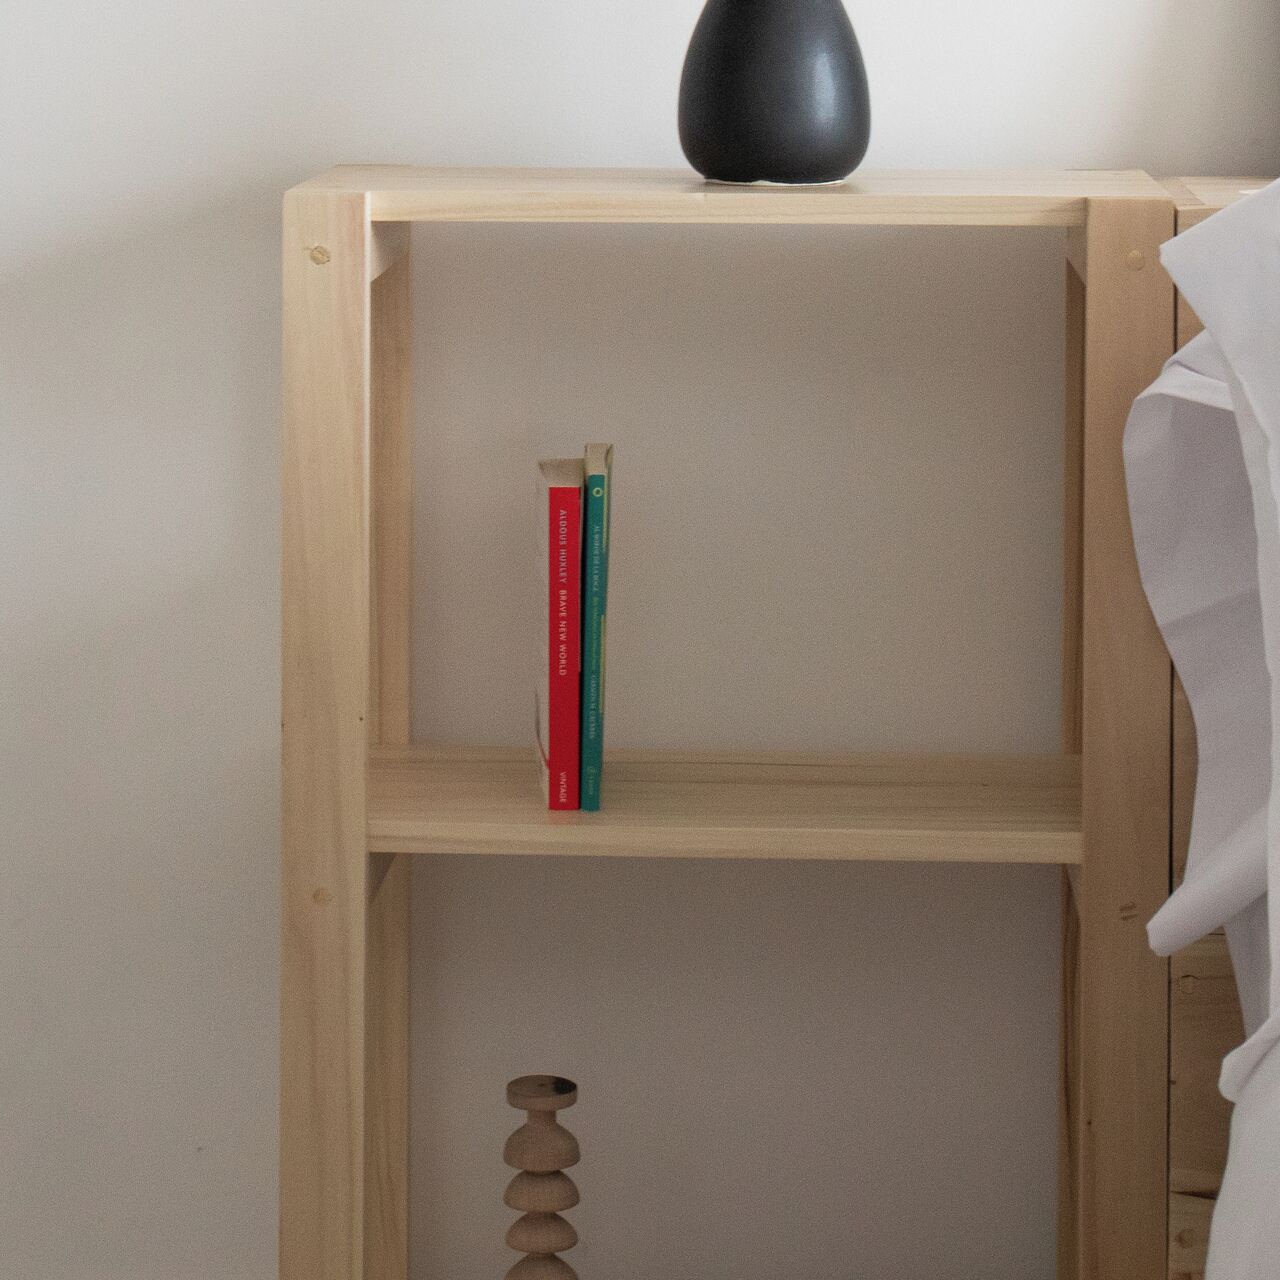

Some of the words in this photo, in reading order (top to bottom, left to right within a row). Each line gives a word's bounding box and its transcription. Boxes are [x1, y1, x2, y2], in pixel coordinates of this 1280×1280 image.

[559, 509, 567, 545] ALDOUS
[559, 549, 567, 583] HUXLEY
[559, 589, 567, 616] BRAVE
[559, 621, 567, 640] NEW
[559, 645, 567, 676] WORLD
[559, 771, 567, 803] VINTAGE
